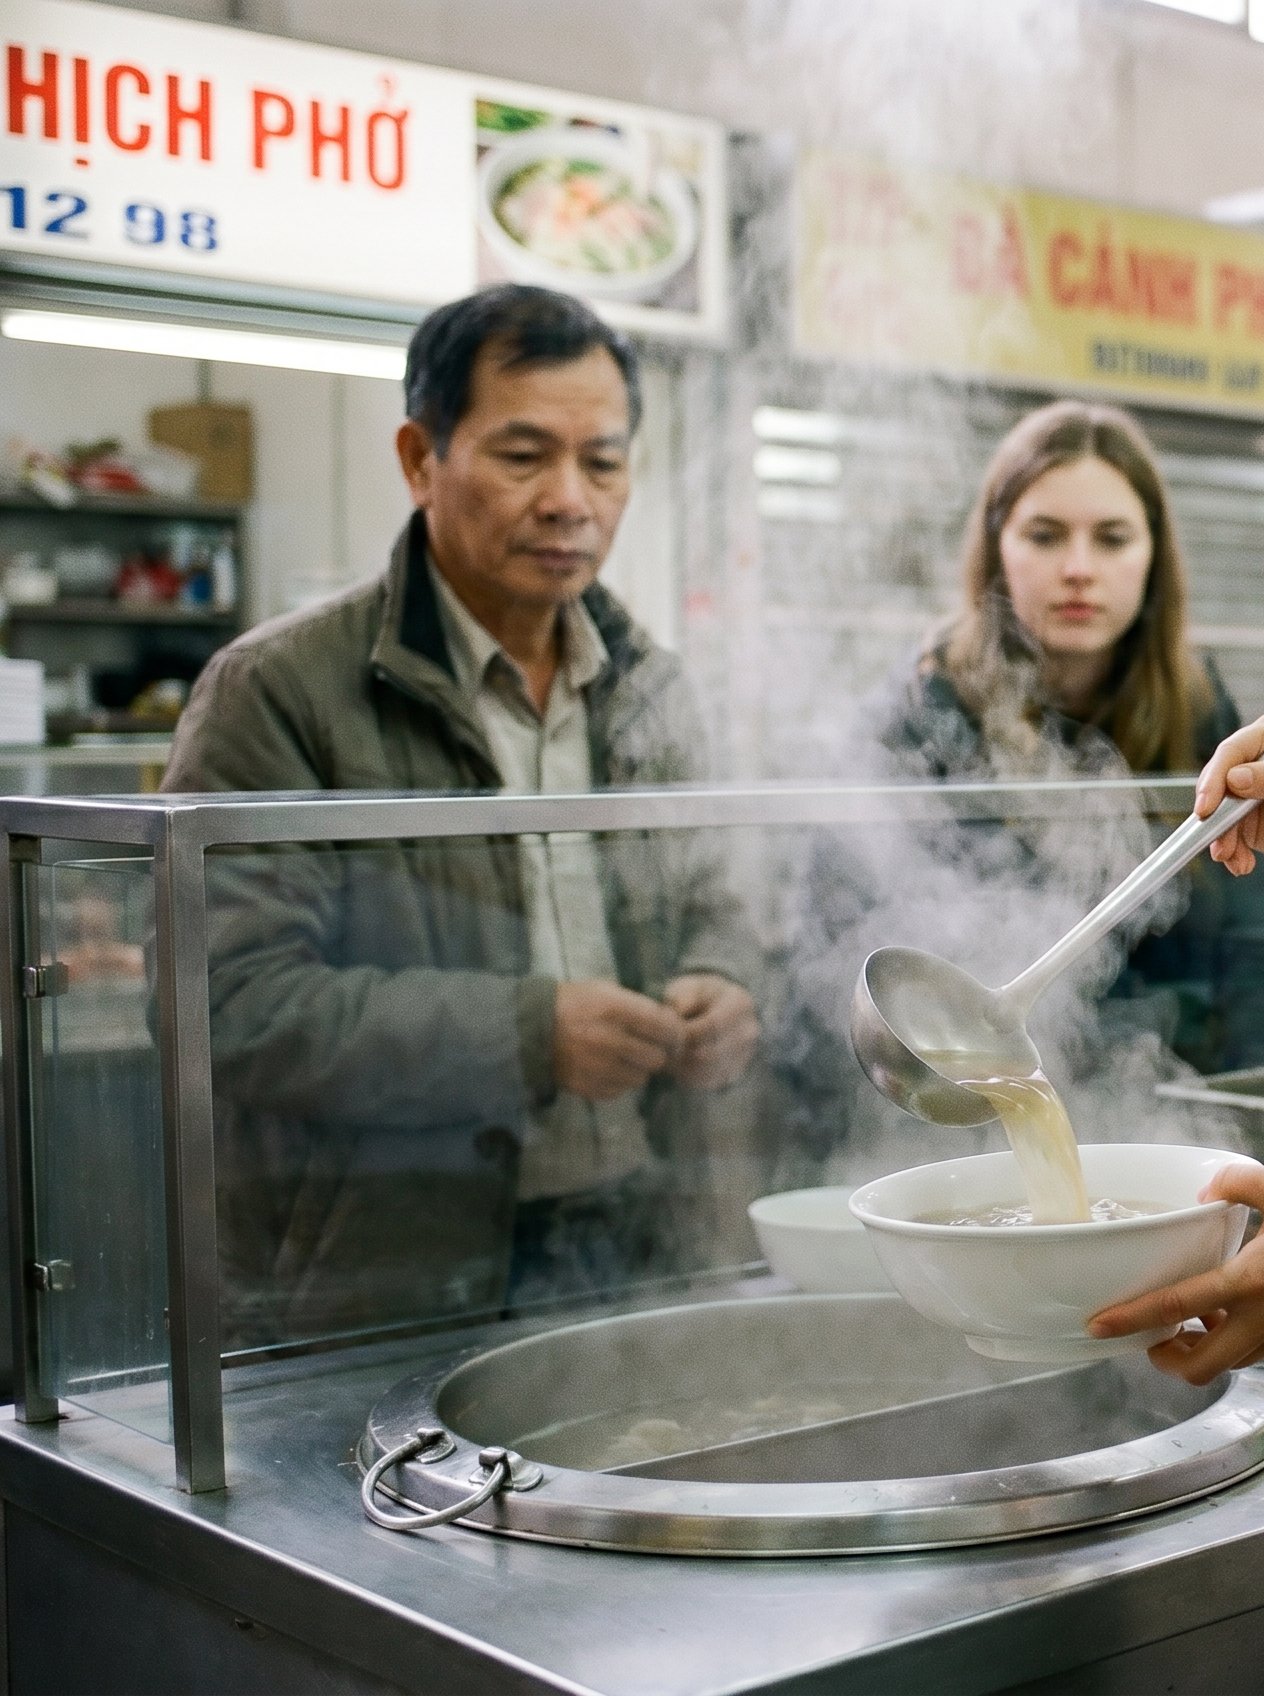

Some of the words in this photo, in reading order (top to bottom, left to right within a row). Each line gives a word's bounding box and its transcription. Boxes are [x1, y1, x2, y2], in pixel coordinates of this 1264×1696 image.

[8, 46, 212, 166] HỊCH
[253, 74, 409, 189] PHỞ
[0, 186, 89, 239] 12
[125, 203, 217, 251] 98
